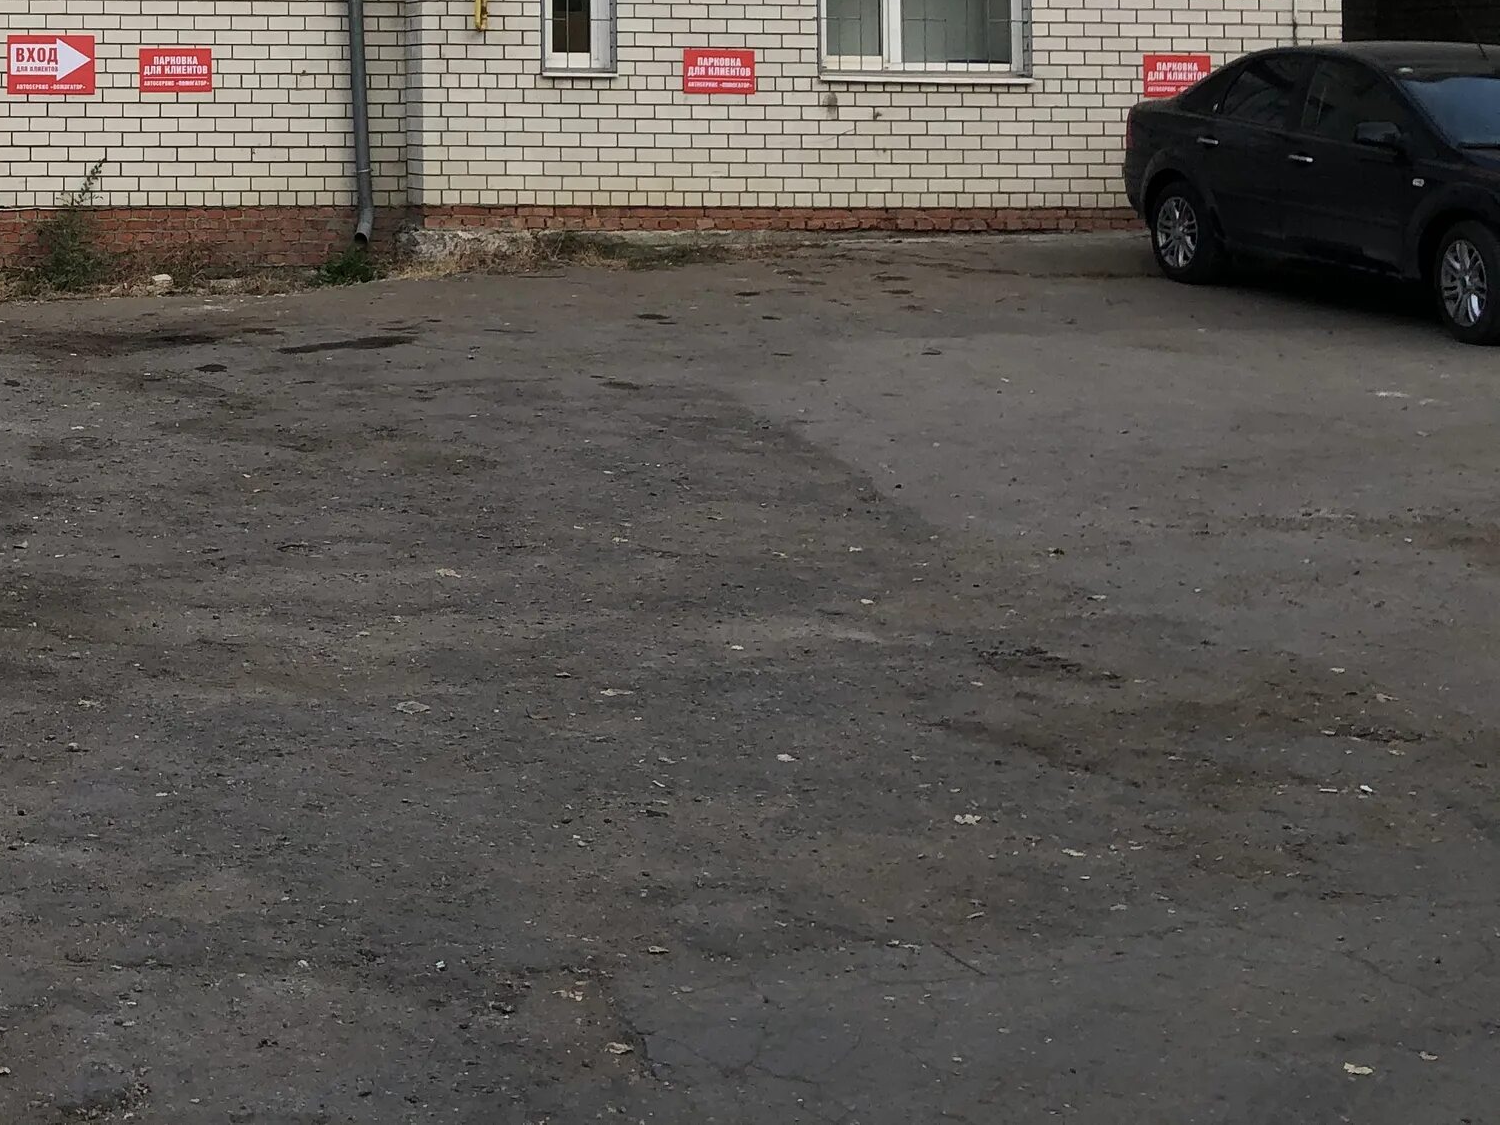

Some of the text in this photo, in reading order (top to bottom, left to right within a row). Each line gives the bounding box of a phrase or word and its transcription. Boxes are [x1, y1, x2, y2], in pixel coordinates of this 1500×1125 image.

[16, 48, 58, 65] ВХОД
[154, 56, 198, 64] ПАРКОВКА
[698, 57, 741, 66] ПАРКОВКА
[144, 66, 207, 75] ДЛЯ КЛИЕНТОВ
[1157, 62, 1198, 71] ПАРКОВКА
[688, 67, 751, 76] ДЛЯ КЛИЕНТОВ
[1148, 71, 1164, 81] ДЛЯ
